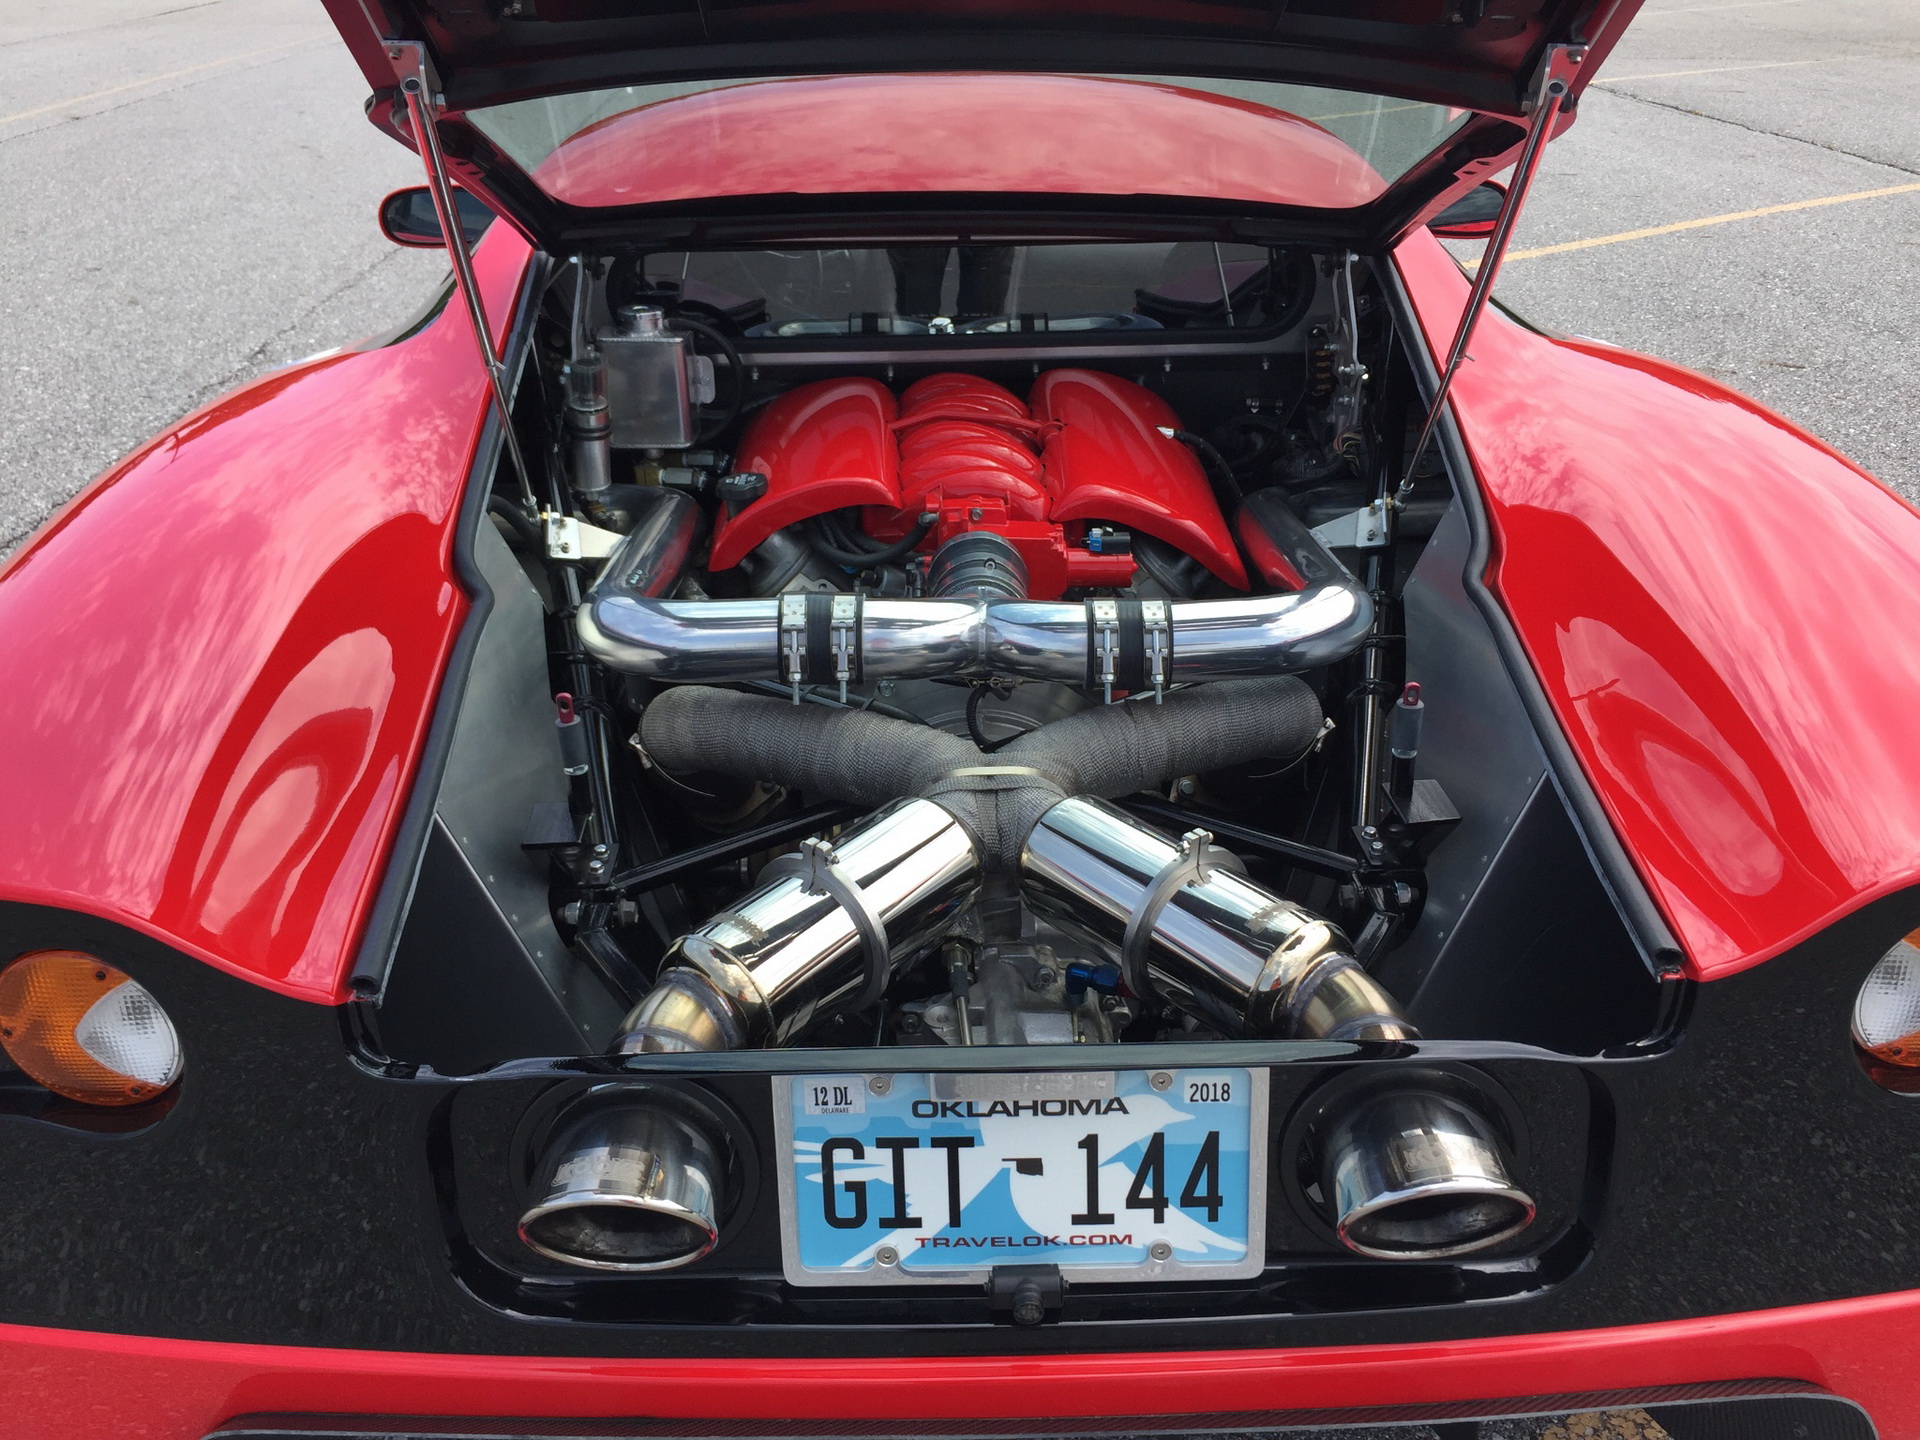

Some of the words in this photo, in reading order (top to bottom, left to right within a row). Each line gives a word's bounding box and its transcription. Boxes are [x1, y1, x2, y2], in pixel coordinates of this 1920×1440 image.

[813, 1087, 829, 1106] 12
[833, 1087, 852, 1106] DL
[1189, 1083, 1231, 1103] 2018
[821, 1107, 850, 1115] DELAWARE
[912, 1096, 1130, 1118] OKLAHOMA
[820, 1136, 975, 1229] GIT
[1071, 1131, 1224, 1225] 144
[915, 1234, 1133, 1248] TRAVELOK.COM
